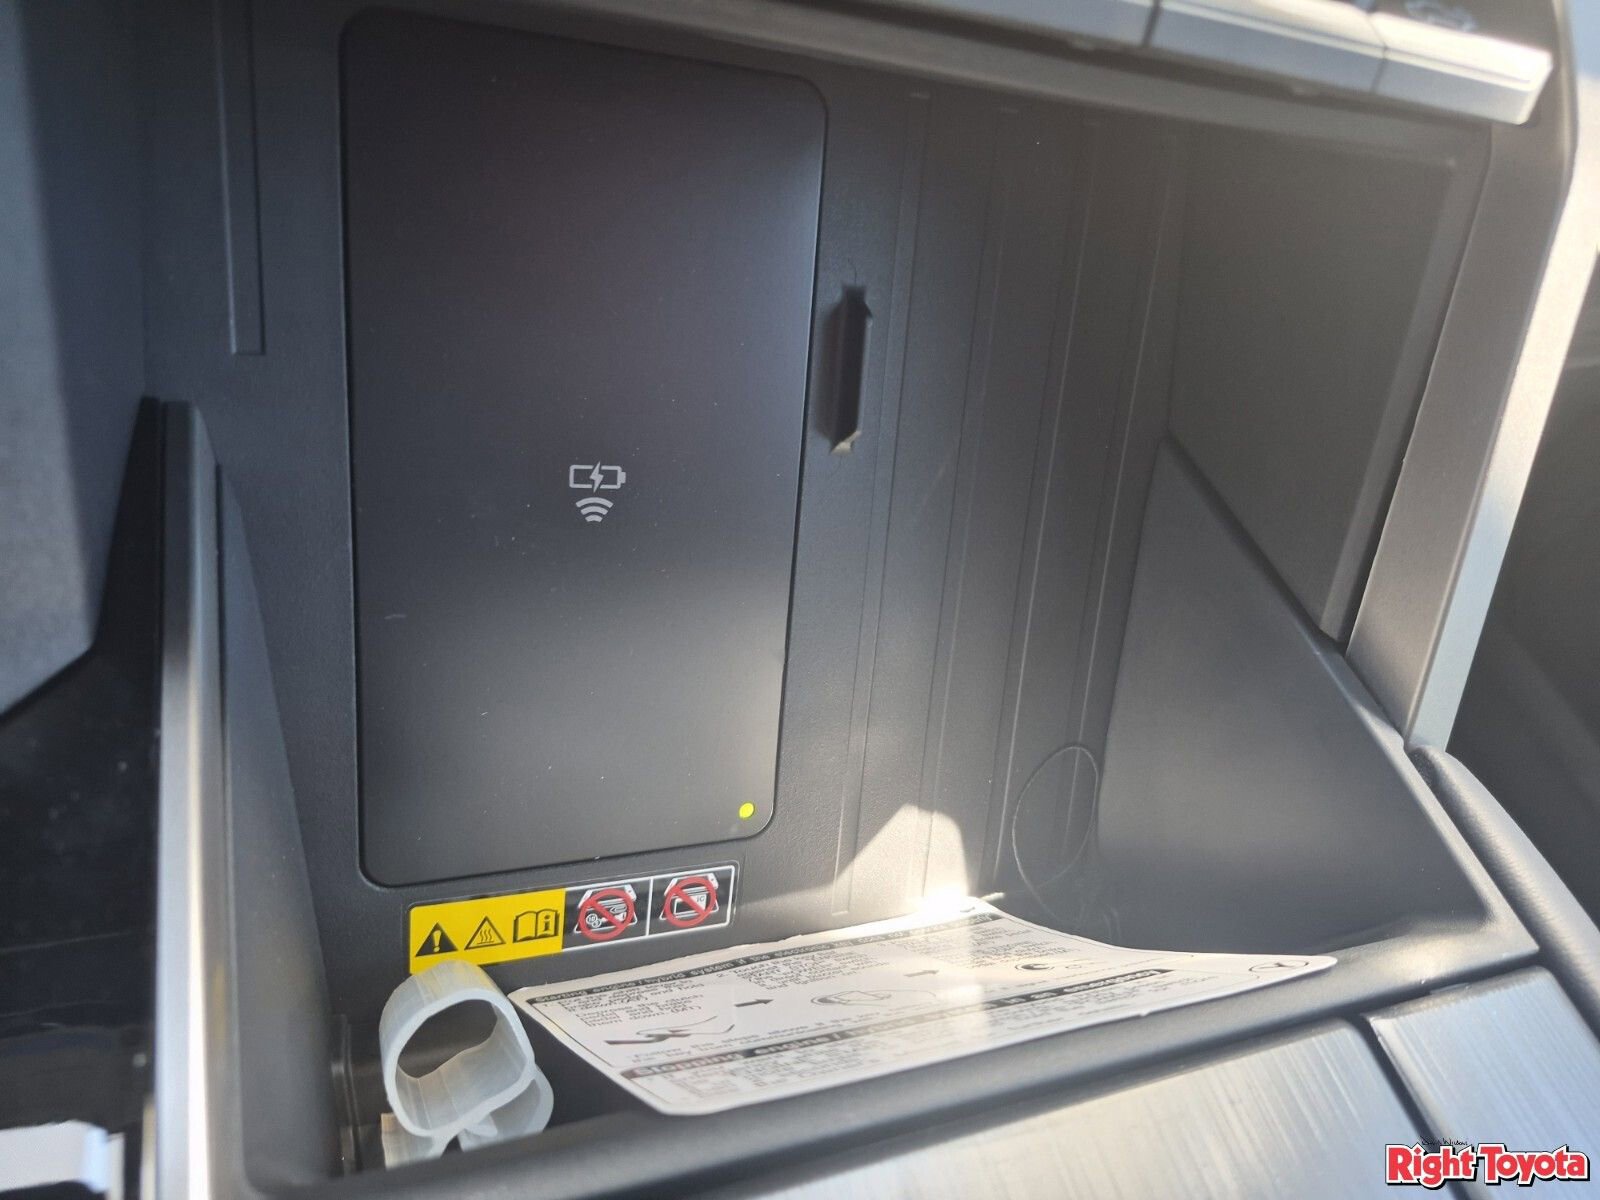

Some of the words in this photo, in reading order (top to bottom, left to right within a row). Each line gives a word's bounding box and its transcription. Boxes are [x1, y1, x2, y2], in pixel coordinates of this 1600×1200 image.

[535, 990, 588, 1003] Starting
[593, 982, 636, 994] engine
[644, 973, 686, 984] hybrid
[690, 963, 734, 976] system
[633, 1053, 744, 1076] Stopping
[754, 1037, 830, 1055] engine
